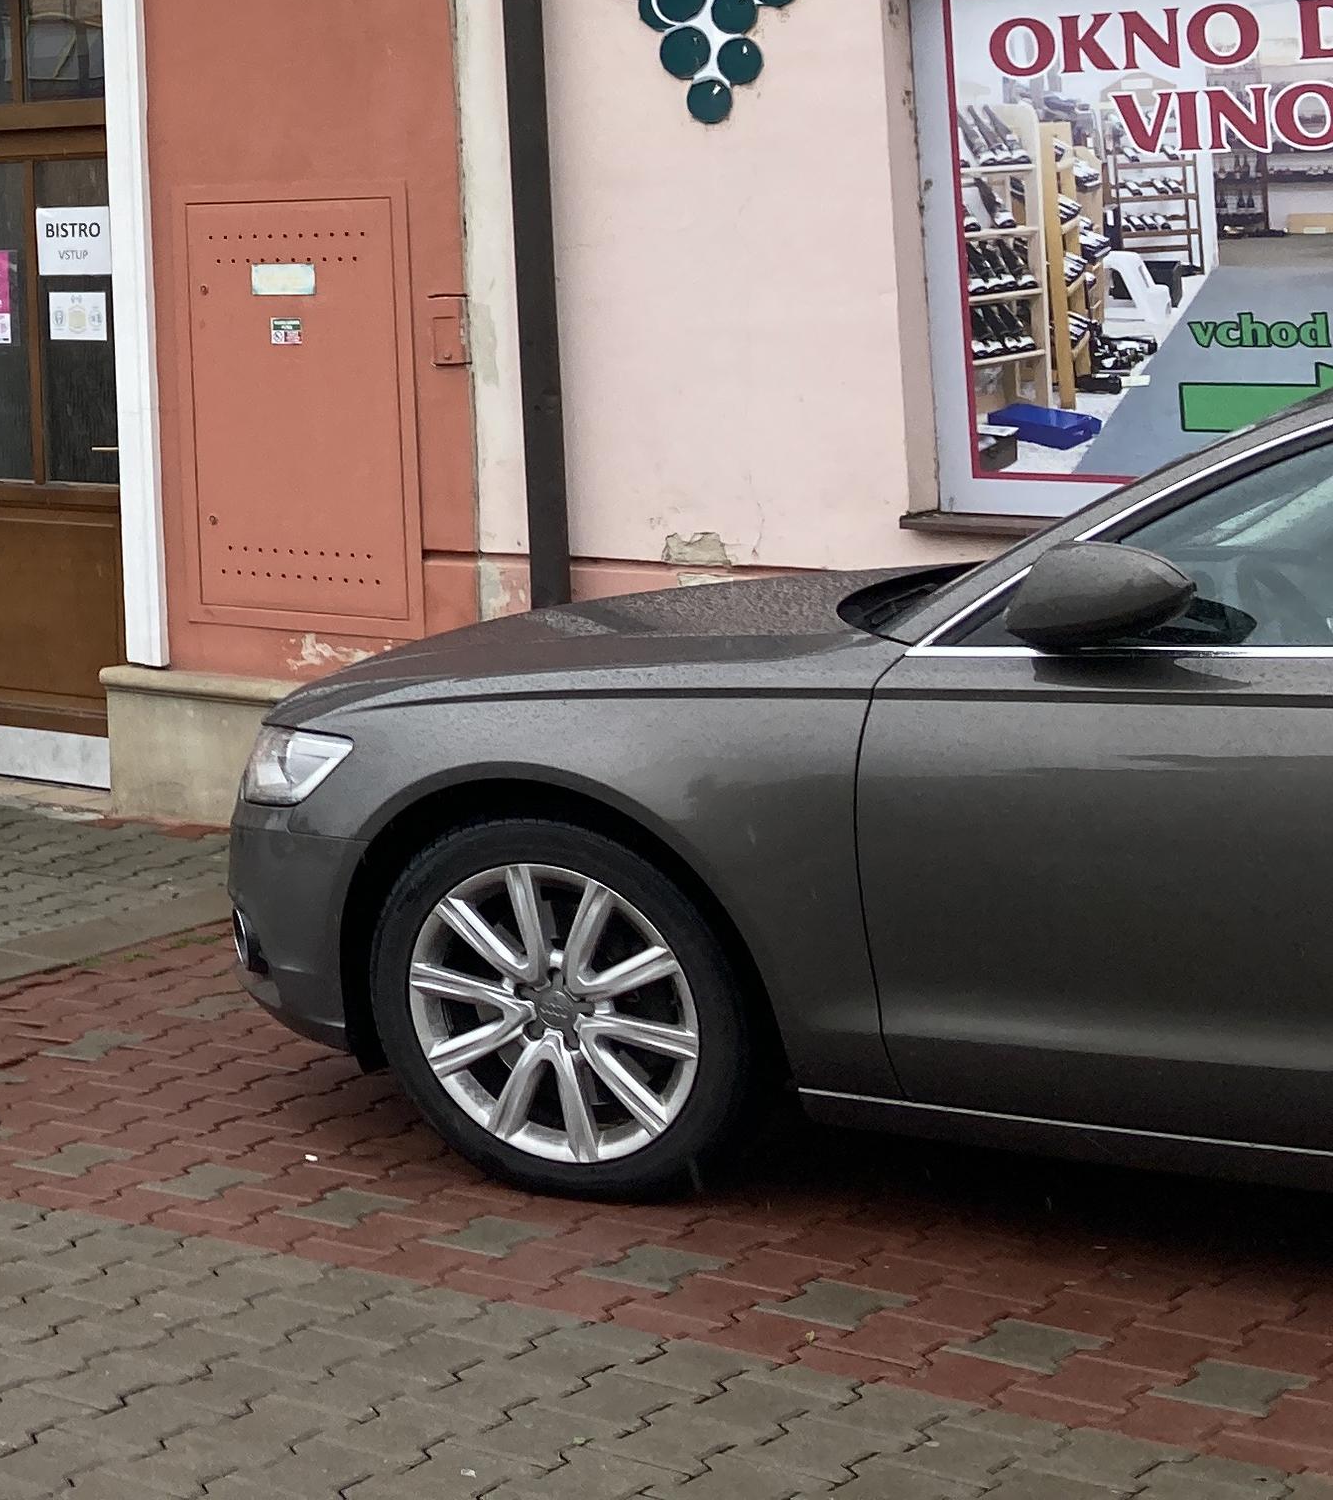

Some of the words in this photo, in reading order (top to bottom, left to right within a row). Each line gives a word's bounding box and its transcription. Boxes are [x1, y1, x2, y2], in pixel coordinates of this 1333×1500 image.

[988, 2, 1260, 77] OKNO
[45, 222, 101, 238] BISTRO
[58, 250, 89, 260] VSTUP
[1187, 312, 1332, 348] vchod
